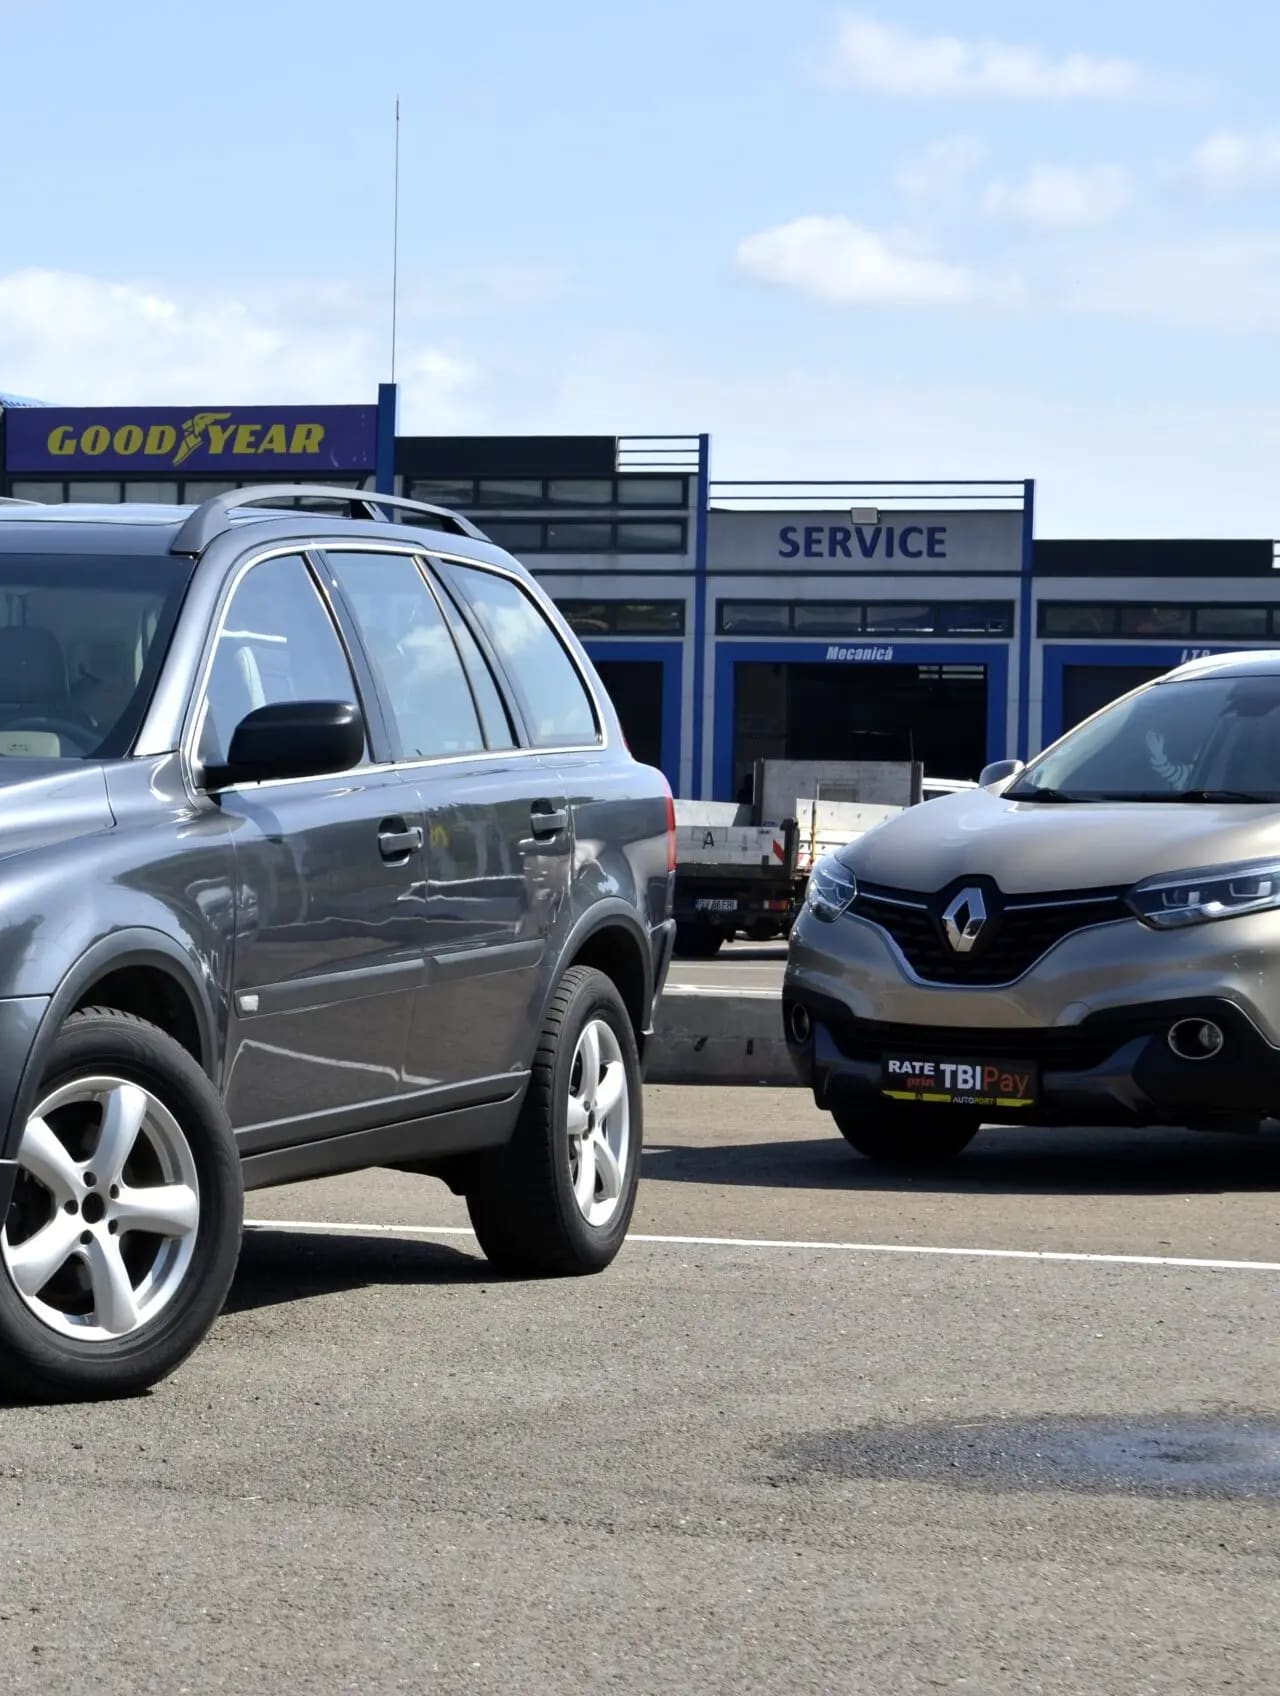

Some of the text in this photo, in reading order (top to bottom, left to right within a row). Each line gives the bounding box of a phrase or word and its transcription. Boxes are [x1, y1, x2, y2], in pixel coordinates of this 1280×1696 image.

[778, 526, 948, 559] SERVICE
[825, 646, 894, 661] Mecanică
[702, 831, 715, 850] A
[888, 1059, 1030, 1098] RATE TBIPay
